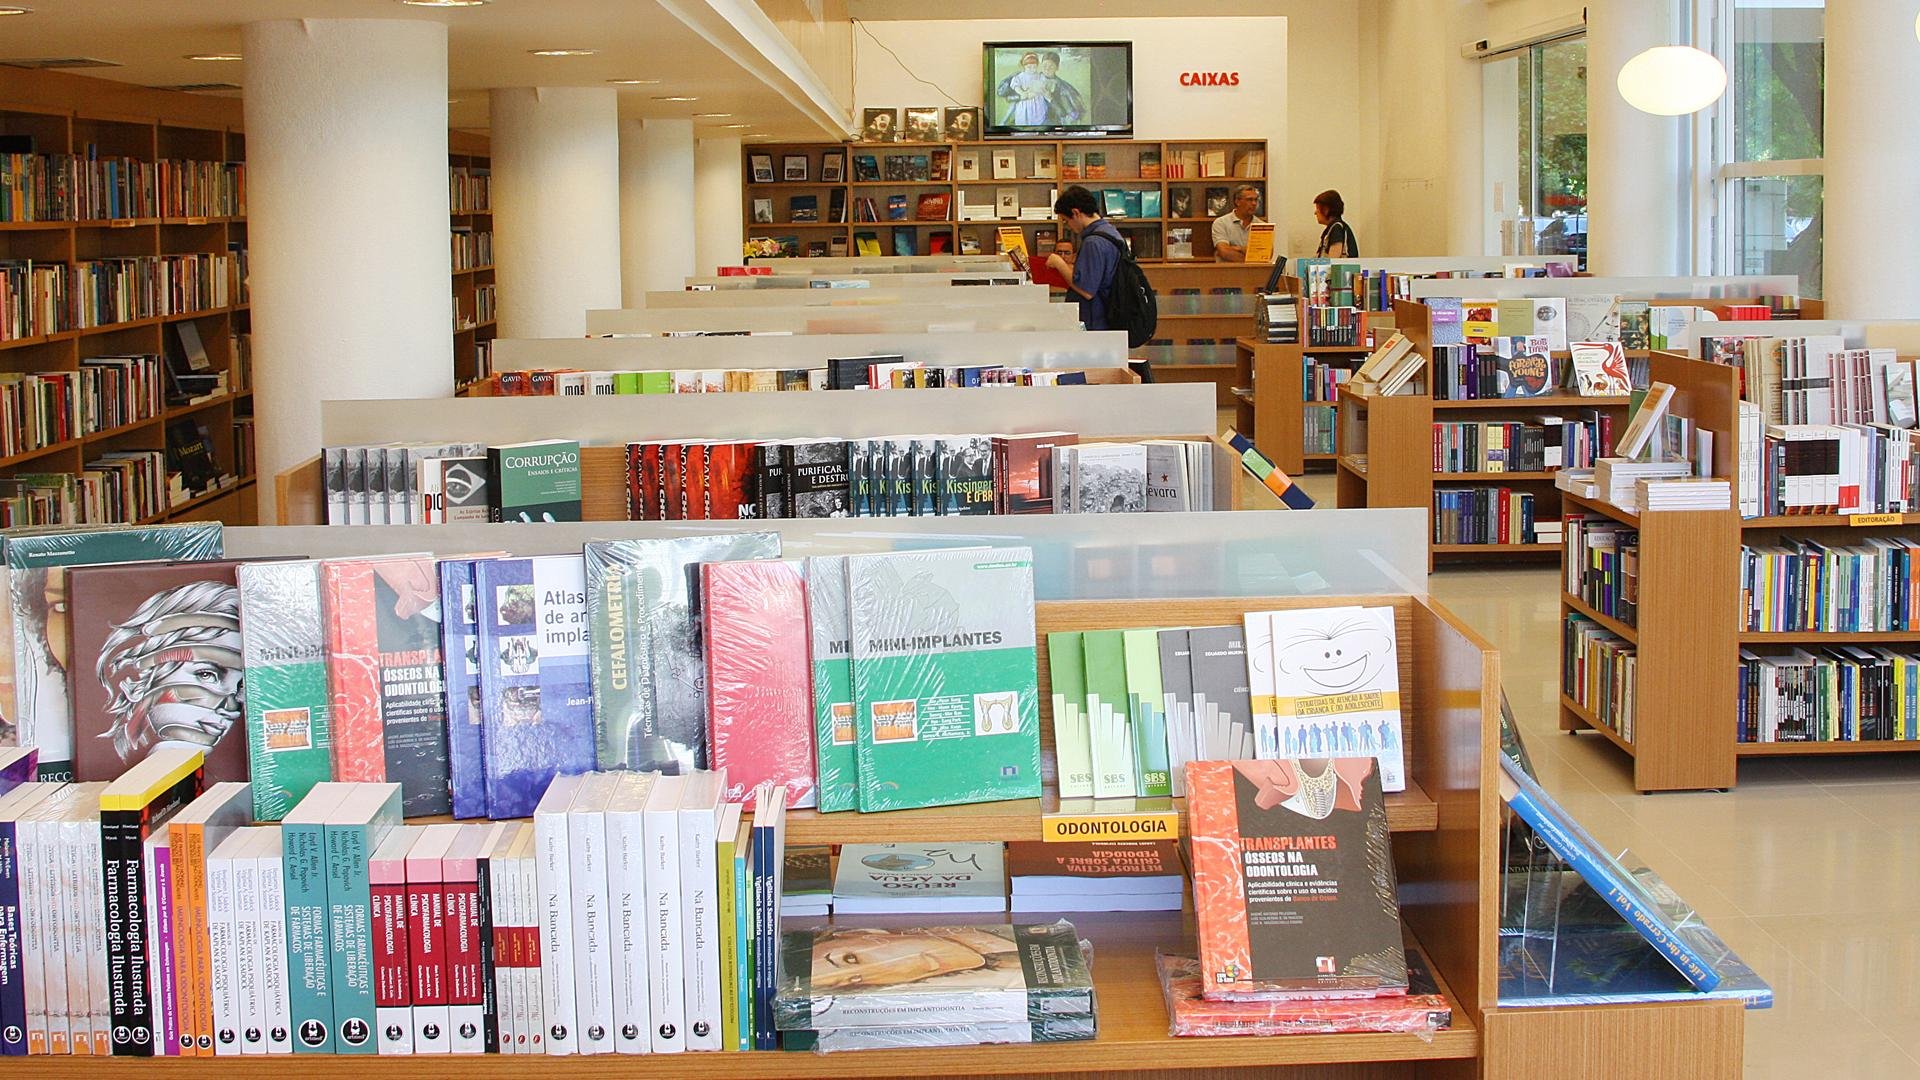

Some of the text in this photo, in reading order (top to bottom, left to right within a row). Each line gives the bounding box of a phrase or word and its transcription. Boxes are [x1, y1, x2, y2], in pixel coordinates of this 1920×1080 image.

[1180, 72, 1240, 86] CAIXAS
[178, 441, 204, 457] Mozart
[505, 451, 577, 470] CORRUPÇÃO
[527, 468, 549, 477] ENSAIOS
[798, 464, 843, 477] PURIFICAR
[811, 476, 816, 485] E
[946, 479, 992, 496] Kissinger
[967, 491, 972, 503] E
[1857, 515, 1895, 524] EDITORAÇÃO
[544, 590, 584, 606] Atlas
[545, 611, 564, 624] de
[868, 631, 1003, 652] MINI-IMPLANTES
[384, 665, 440, 682] ÓSSEOS NA
[1344, 701, 1381, 710] ADOLESCENTE
[1104, 773, 1125, 784] SBS
[1144, 772, 1166, 783] SBS
[1057, 820, 1167, 836] ODONTOLOGIA
[1239, 836, 1338, 851] TRANSPLANTES
[289, 833, 298, 880] Howard Ansel
[310, 855, 318, 870] Allen
[1092, 850, 1159, 858] PEDOLOGIA
[1112, 857, 1161, 865] CRÍTICA
[1244, 851, 1303, 864] ÓSSEOS NA
[1067, 864, 1163, 873] RETROSPECTIVA
[1246, 864, 1318, 878] ODONTOLOGIA
[300, 866, 309, 893] Popovich
[869, 875, 933, 883] ÁGUA
[882, 881, 956, 890] REÚSO
[1248, 880, 1285, 889] Aplicabilidade
[623, 892, 630, 907] Na
[660, 892, 667, 907] Na
[695, 890, 702, 905] Na
[754, 876, 762, 906] Vigilância
[1248, 888, 1276, 896] científicas
[1277, 887, 1292, 895] sobre
[373, 895, 381, 918] CLÍNICA
[410, 893, 418, 916] CLÍNICA
[432, 893, 440, 918] MANUAL
[446, 893, 454, 915] CLÍNICA
[469, 892, 477, 917] MANUAL
[549, 893, 557, 908] Na
[587, 894, 595, 909] Na
[1249, 896, 1283, 904] provenientes
[395, 895, 404, 928] MANUAL DE
[194, 907, 203, 954] IMUNOLOGIA
[384, 895, 394, 954] PSICOFARMACOLOGIA
[421, 893, 431, 953] PSICOFARMACOLOGIA
[458, 893, 468, 952] PSICOFARMACOLOGIA
[550, 910, 560, 952] Bancada
[624, 909, 633, 952] Bancada
[661, 909, 670, 951] Bancada
[696, 907, 705, 950] Bancada
[7, 906, 17, 970] Bases Teóricas
[107, 860, 127, 1015] Farmacologia Ilustrada
[127, 860, 146, 1015] Farmacologia Ilustrada
[588, 911, 598, 953] Bancada
[1616, 895, 1705, 981] Life in the Cerrado Vol.
[302, 906, 315, 989] SISTEMAS LIBERAÇÃO
[313, 906, 327, 990] FORMAS FARMACÊUTICAS
[344, 904, 357, 987] SISTEMAS LIBERAÇÃO
[355, 905, 369, 989] FORMAS FARMACÊUTICAS
[177, 906, 185, 954] IMUNOLOGIA
[181, 976, 189, 1031] ODONTOLOGIA
[270, 921, 281, 1016] FARMACOLOGIA PSIQUIÁTRICA
[198, 976, 208, 1031] ODONTOLOGIA
[247, 974, 255, 1017] PSIQUIÁTRICA
[842, 1007, 896, 1015] RECONSTRUÇÕES
